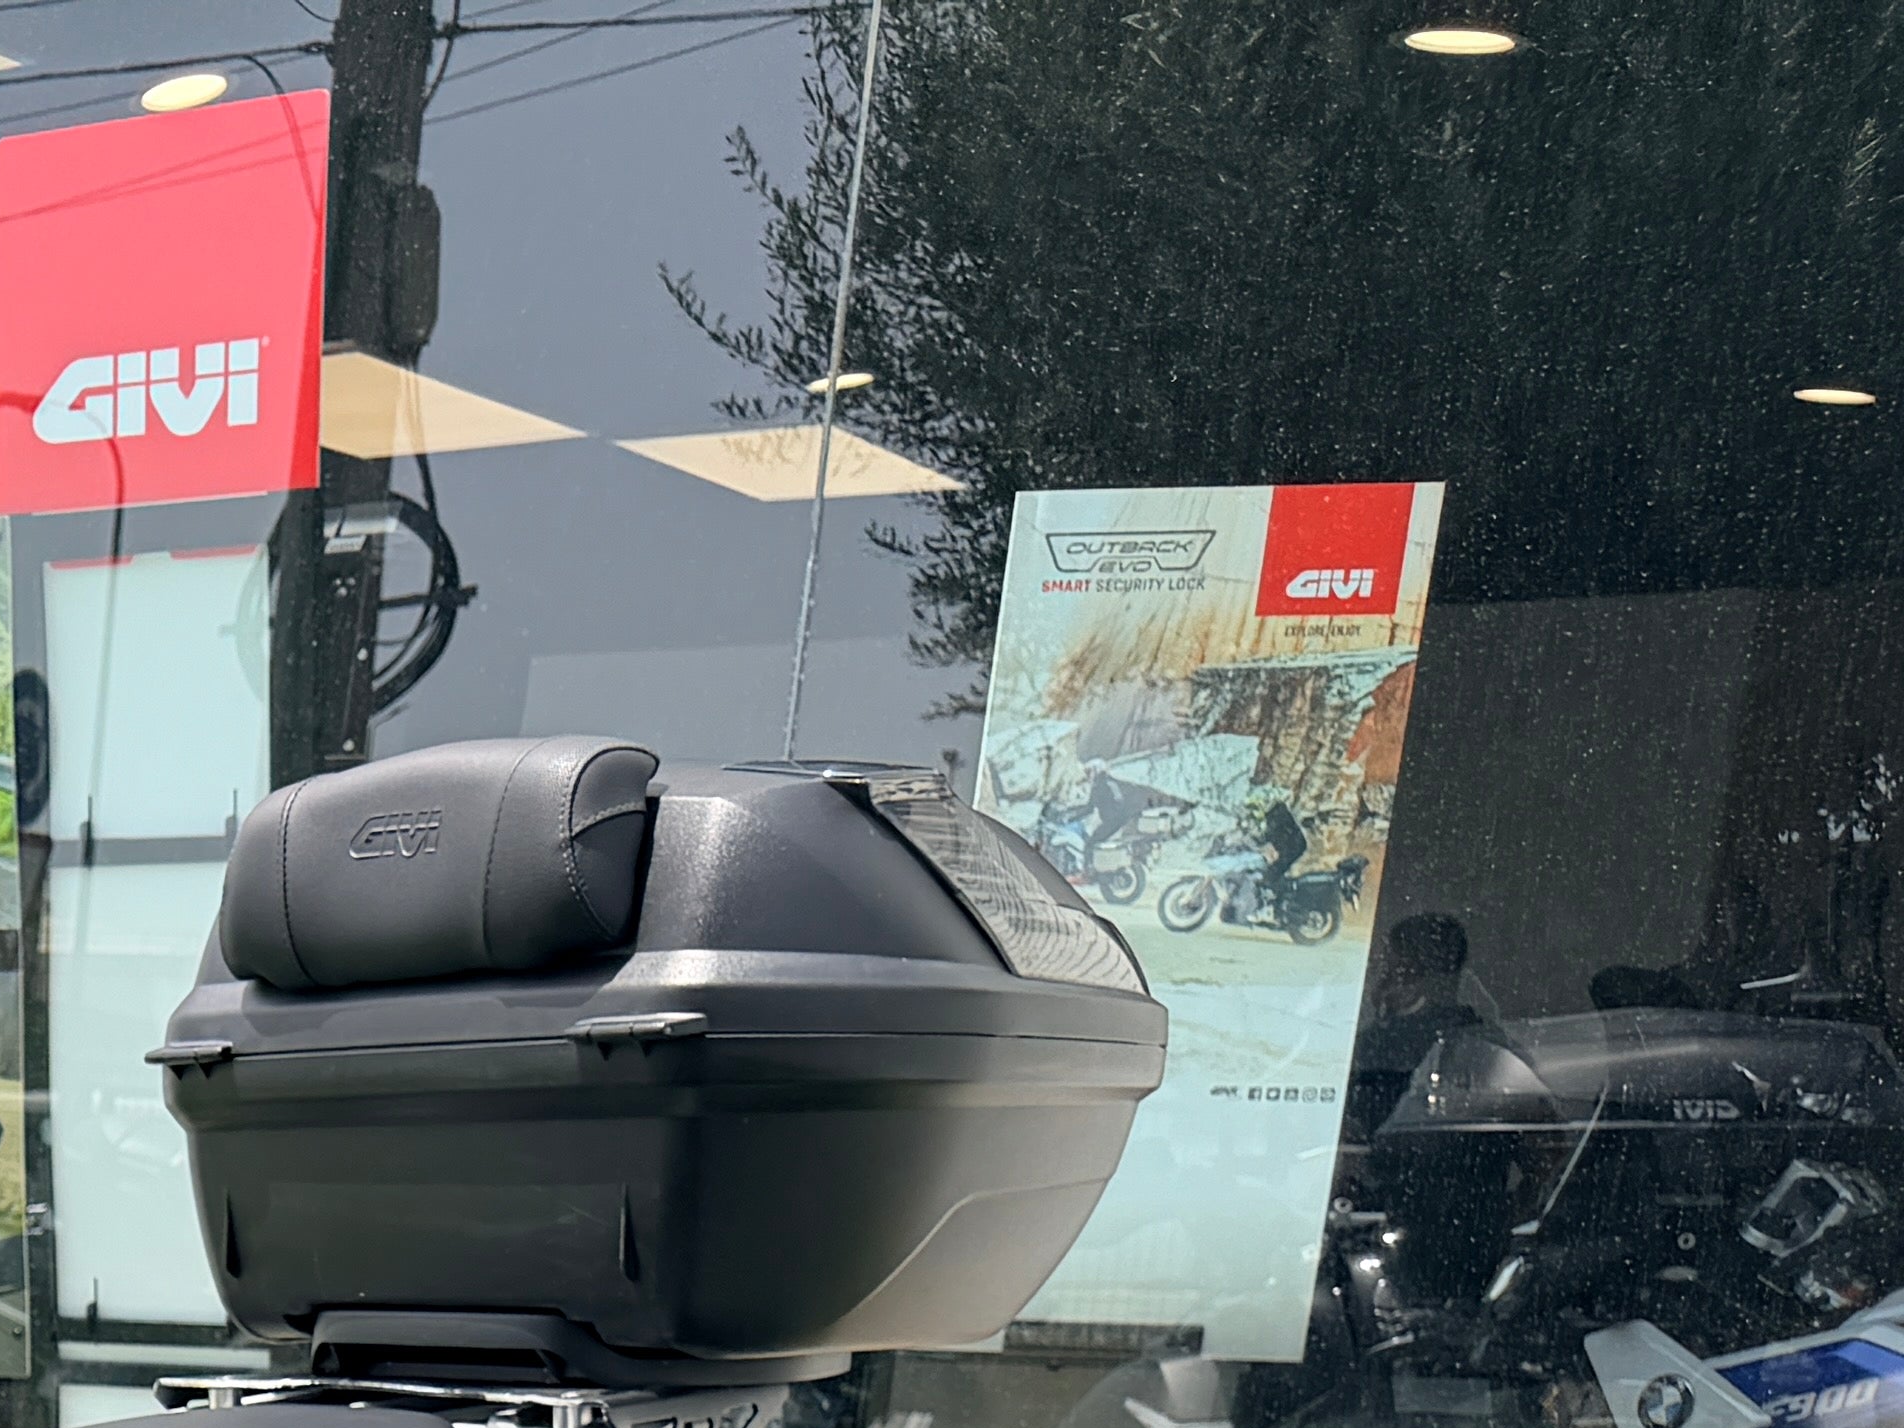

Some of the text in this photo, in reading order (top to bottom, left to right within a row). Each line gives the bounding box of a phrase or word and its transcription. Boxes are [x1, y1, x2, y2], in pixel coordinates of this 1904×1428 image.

[33, 338, 259, 444] GIVI
[1066, 540, 1193, 555] OUTBACK
[1099, 560, 1152, 573] EVO
[1042, 575, 1206, 593] SMART SECURITY LOCK
[1286, 568, 1375, 599] GIVI
[349, 808, 442, 860] GIVI
